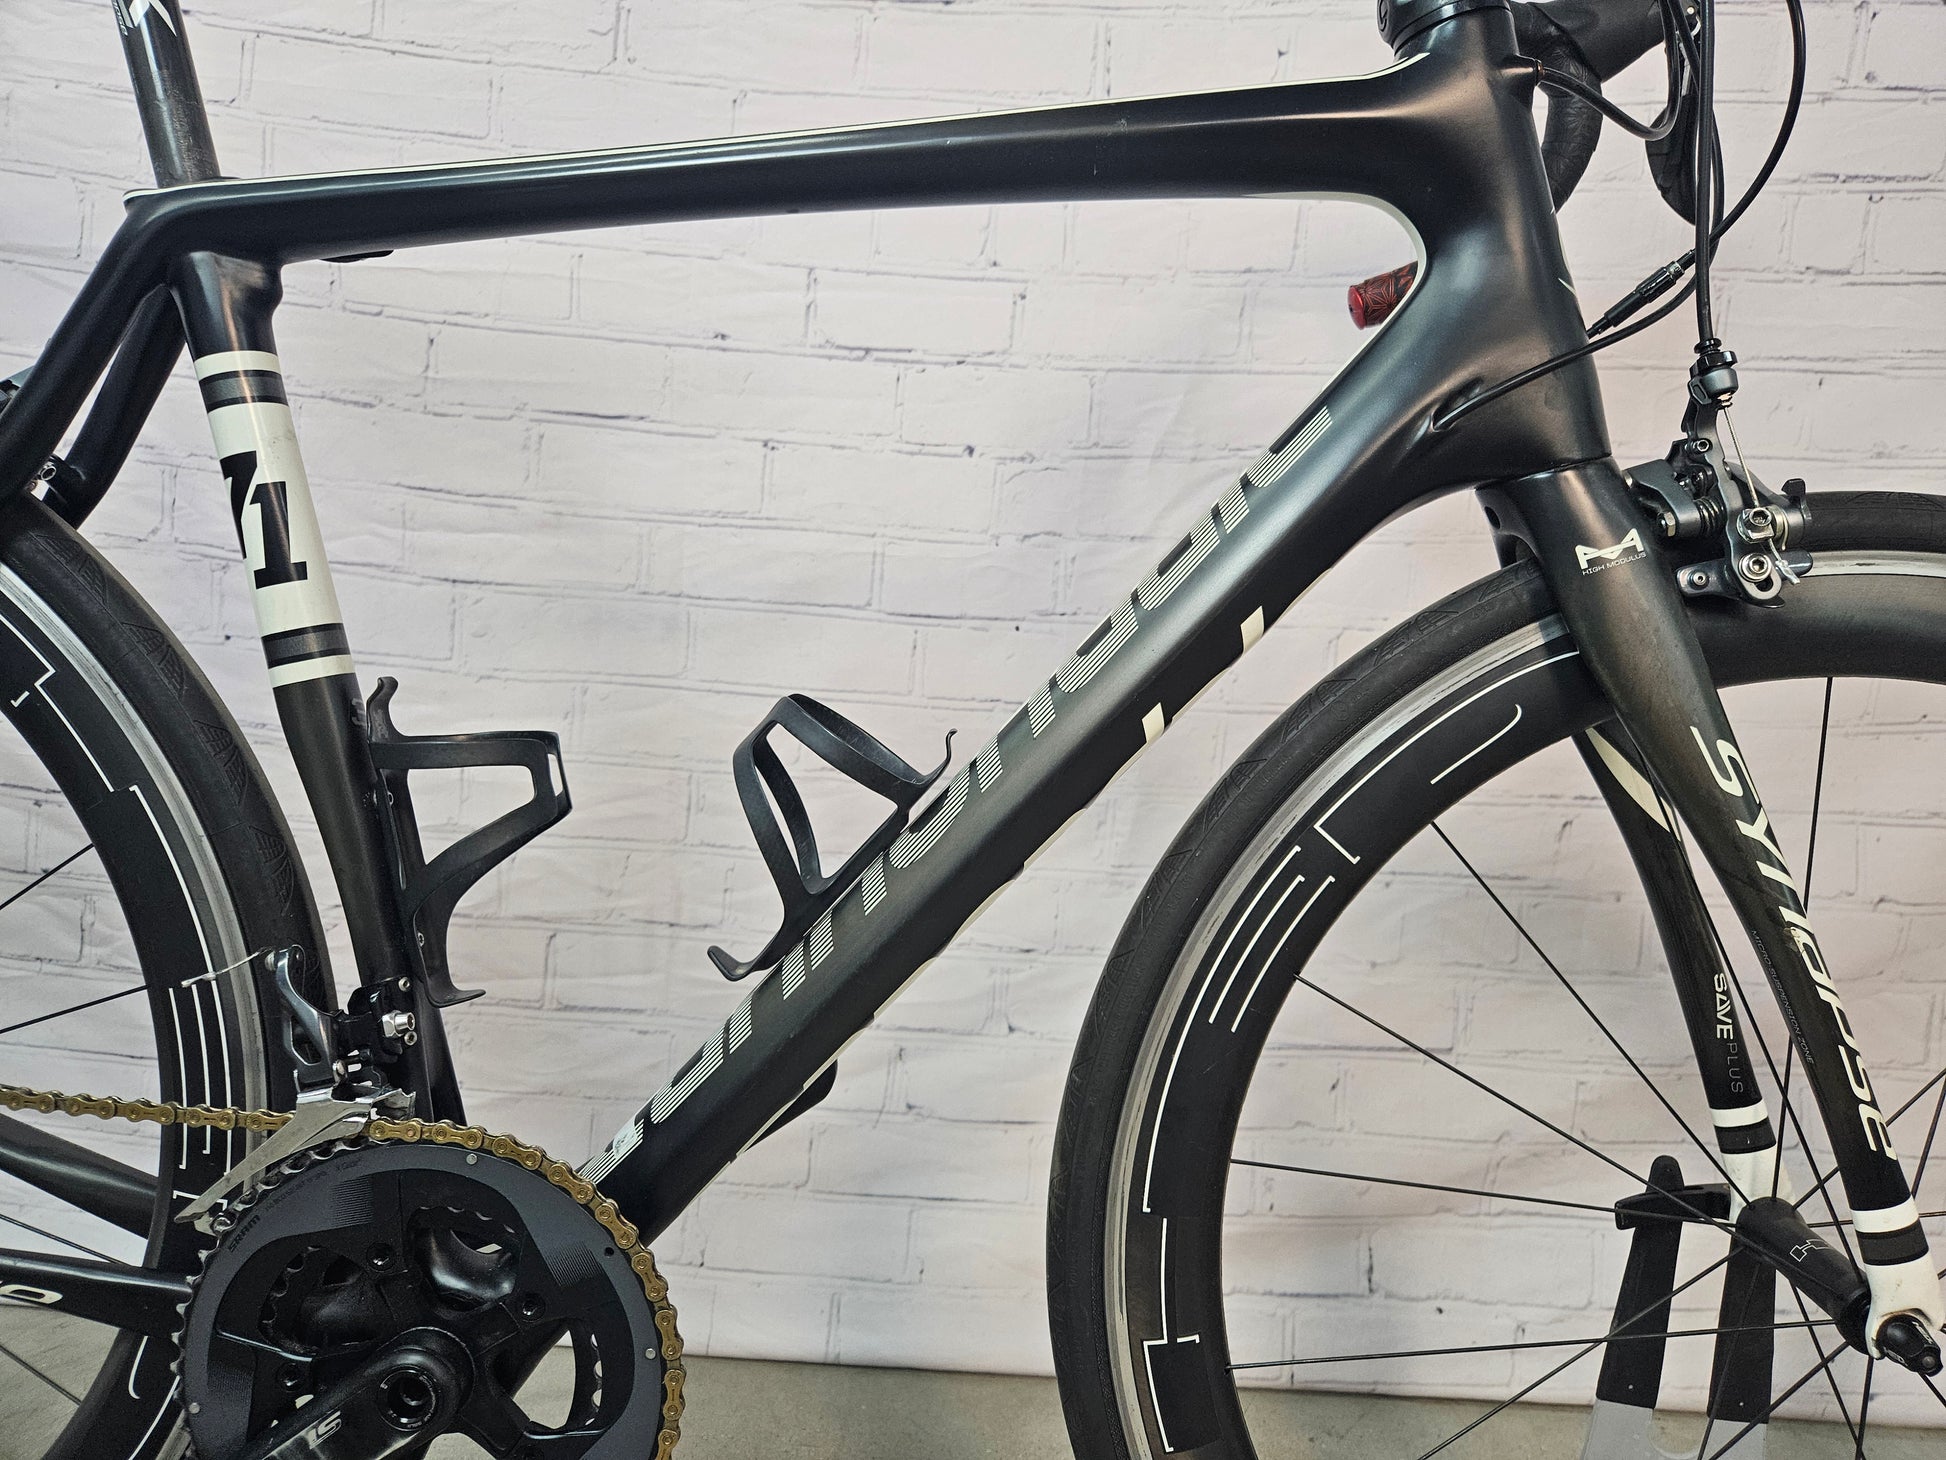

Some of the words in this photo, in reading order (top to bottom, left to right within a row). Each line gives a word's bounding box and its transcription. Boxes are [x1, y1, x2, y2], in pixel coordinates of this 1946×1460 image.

[1582, 564, 1605, 576] HIGH
[1606, 551, 1647, 569] MODULUS
[1751, 930, 1772, 965] MICRO
[1768, 967, 1801, 1040] SUSPENSION
[1797, 1039, 1815, 1064] ZONE
[1726, 1042, 1744, 1093] PLUS
[228, 1214, 262, 1253] SRAM
